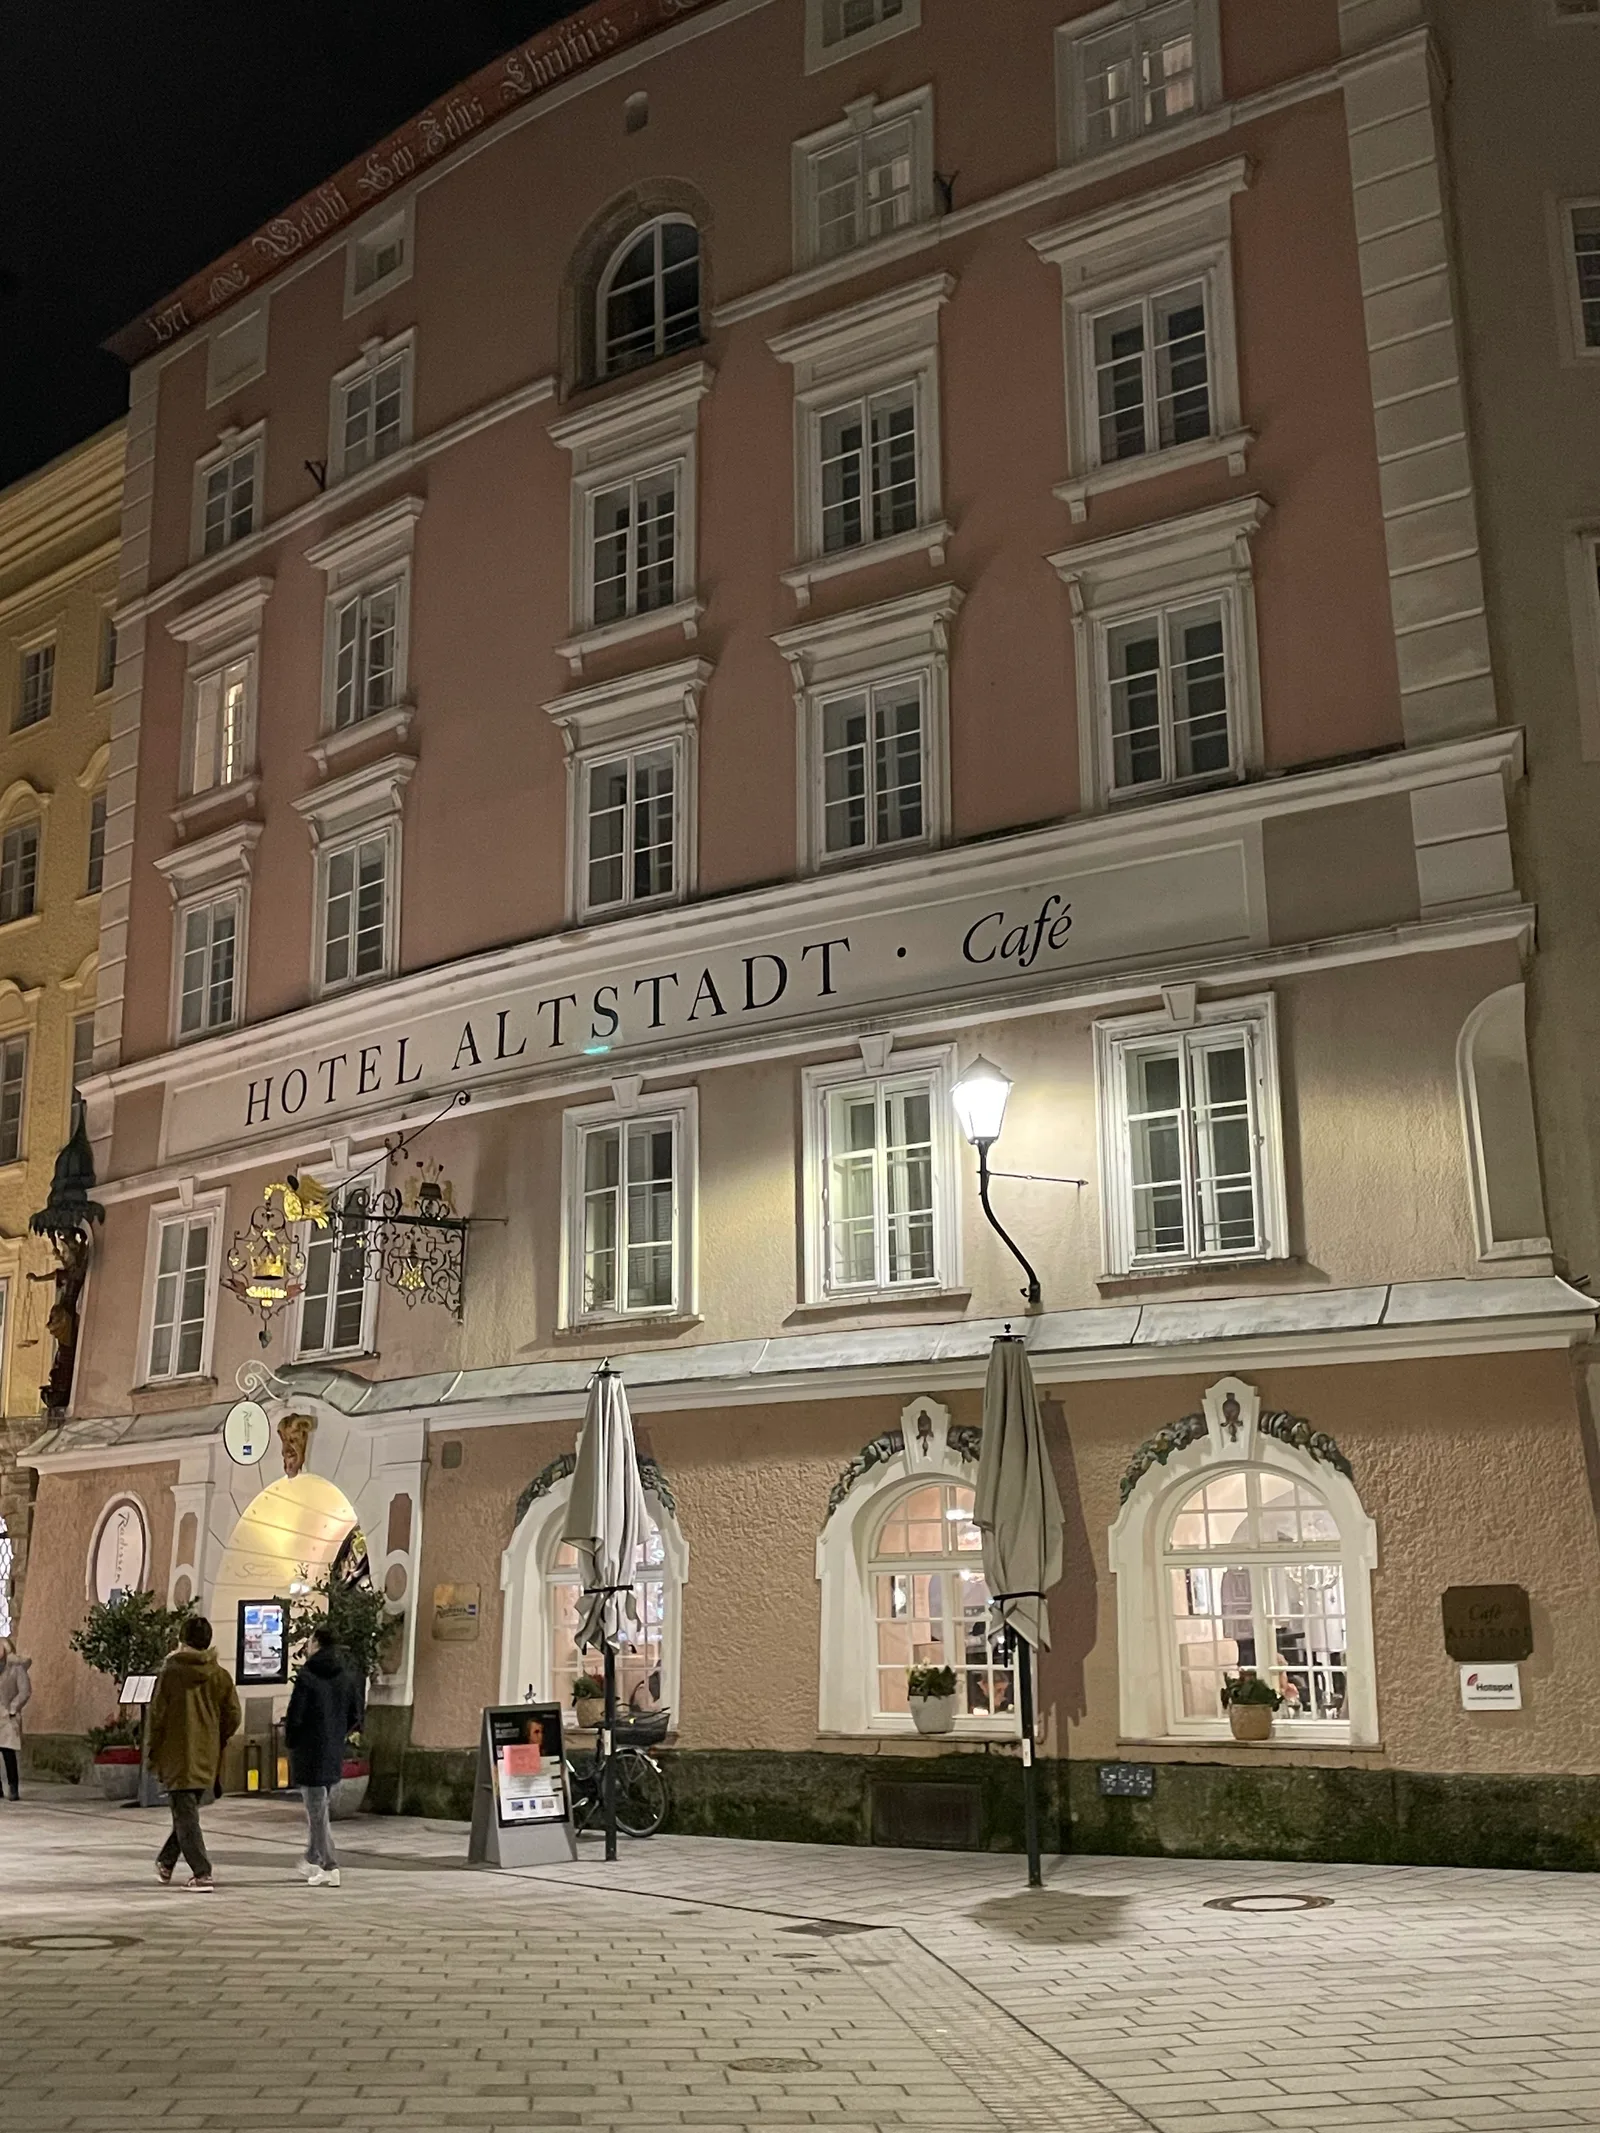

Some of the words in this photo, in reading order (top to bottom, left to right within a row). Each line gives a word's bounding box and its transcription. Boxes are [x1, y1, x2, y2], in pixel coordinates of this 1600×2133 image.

[244, 1037, 423, 1127] HOTEL
[451, 937, 852, 1071] ALTSTADT
[963, 894, 1074, 970] Café
[115, 1511, 130, 1584] Radisson
